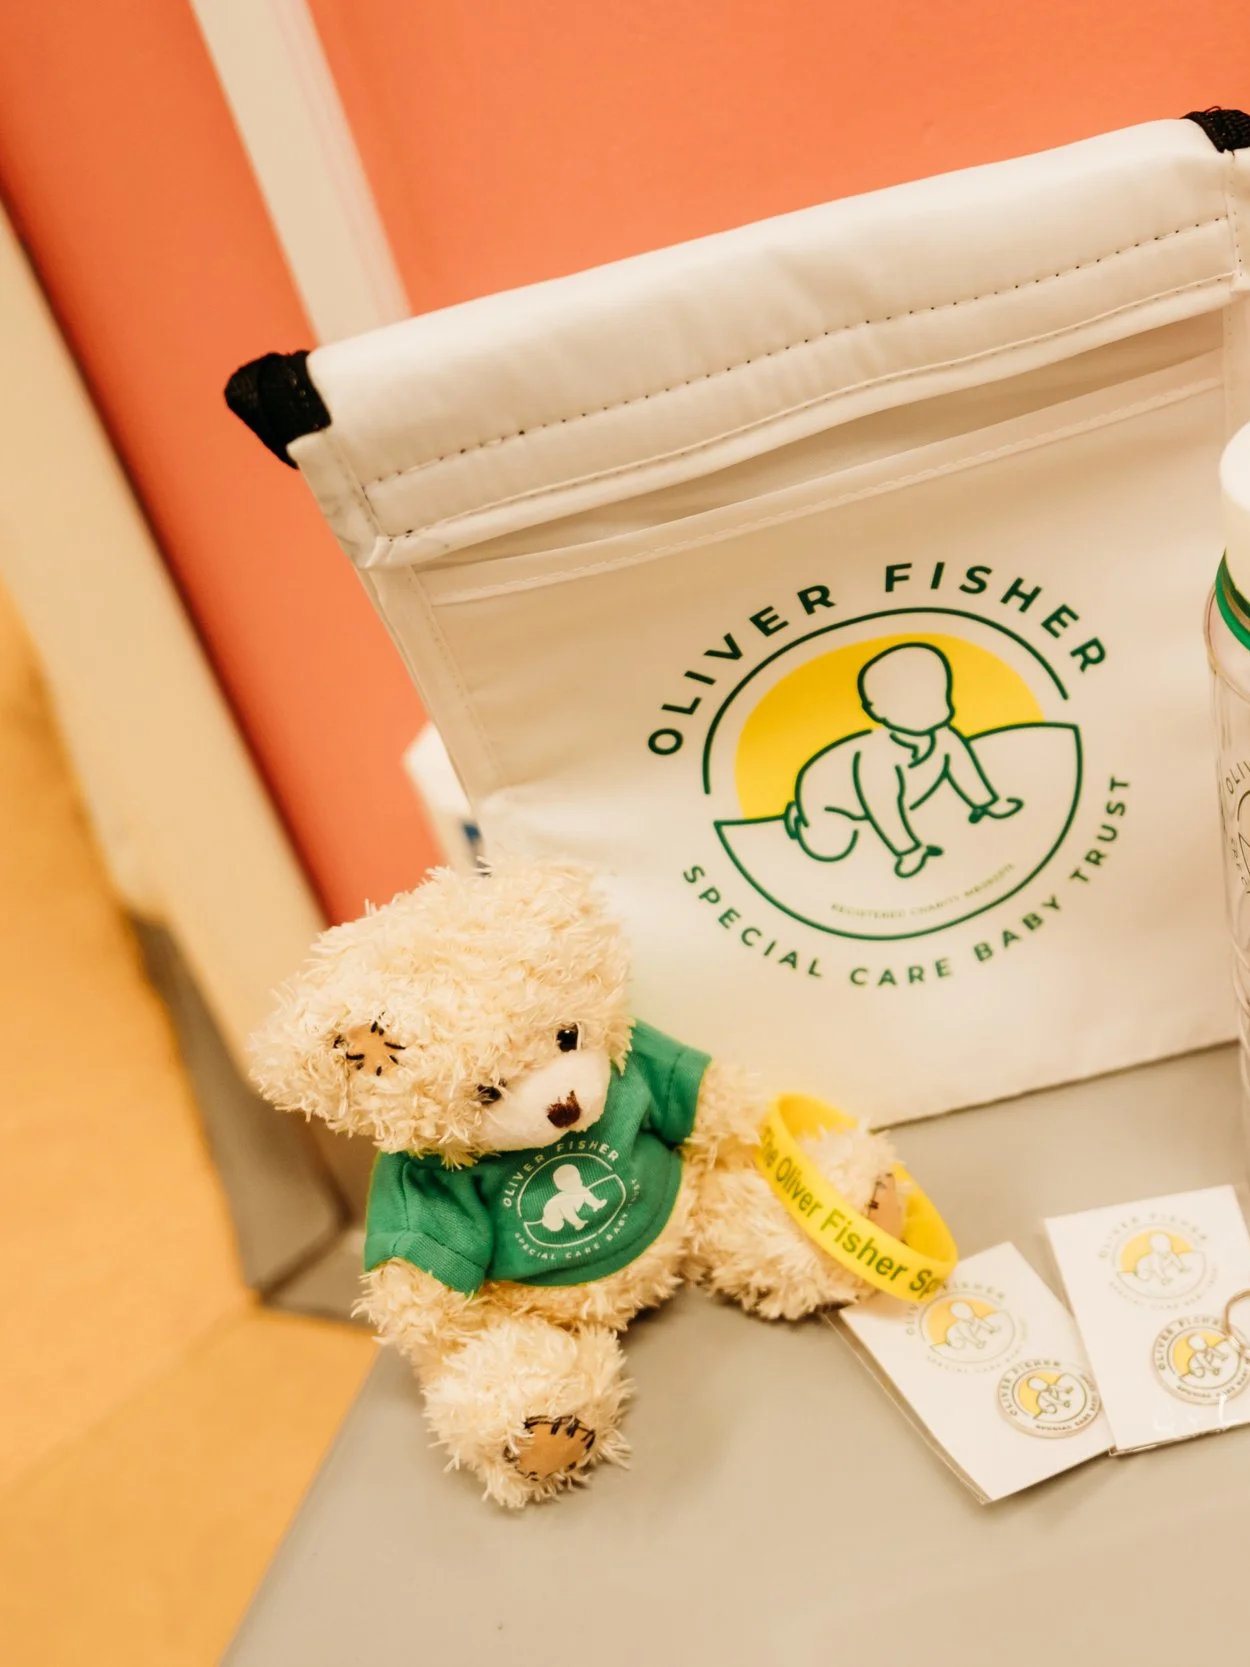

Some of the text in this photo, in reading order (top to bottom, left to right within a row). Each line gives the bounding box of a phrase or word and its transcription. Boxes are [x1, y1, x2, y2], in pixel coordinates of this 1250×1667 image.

[647, 561, 1107, 757] OLIVER FISHER
[683, 864, 823, 979] SPECIAL
[850, 957, 953, 987] CARE
[973, 895, 1063, 963] BABY
[1069, 776, 1131, 885] TRUST
[503, 1140, 620, 1208] OLIVER FISHER
[775, 1156, 824, 1218] Oliver
[820, 1208, 909, 1282] Fisher
